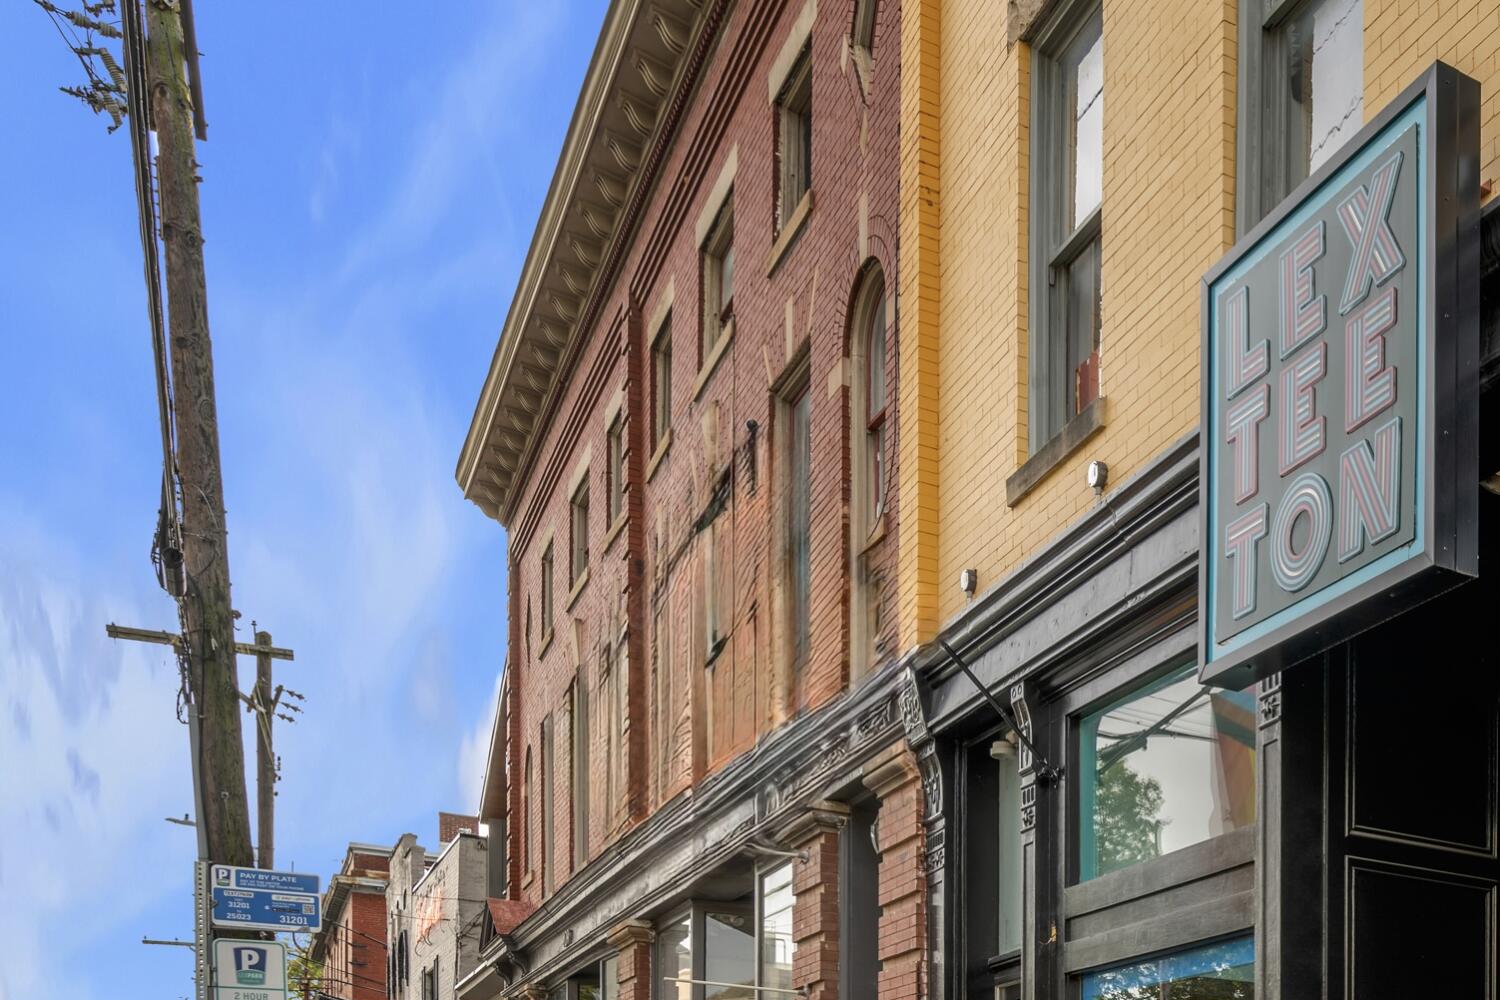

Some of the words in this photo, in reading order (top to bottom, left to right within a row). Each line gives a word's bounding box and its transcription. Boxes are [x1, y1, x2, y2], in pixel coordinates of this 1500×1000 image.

[1225, 150, 1406, 400] LEX
[1225, 285, 1399, 505] TEE
[1225, 415, 1402, 620] TON
[271, 875, 297, 883] PLATE
[279, 915, 308, 925] 31201
[241, 949, 260, 970] P
[234, 992, 240, 1000] 2
[243, 992, 269, 1000] HOUR
